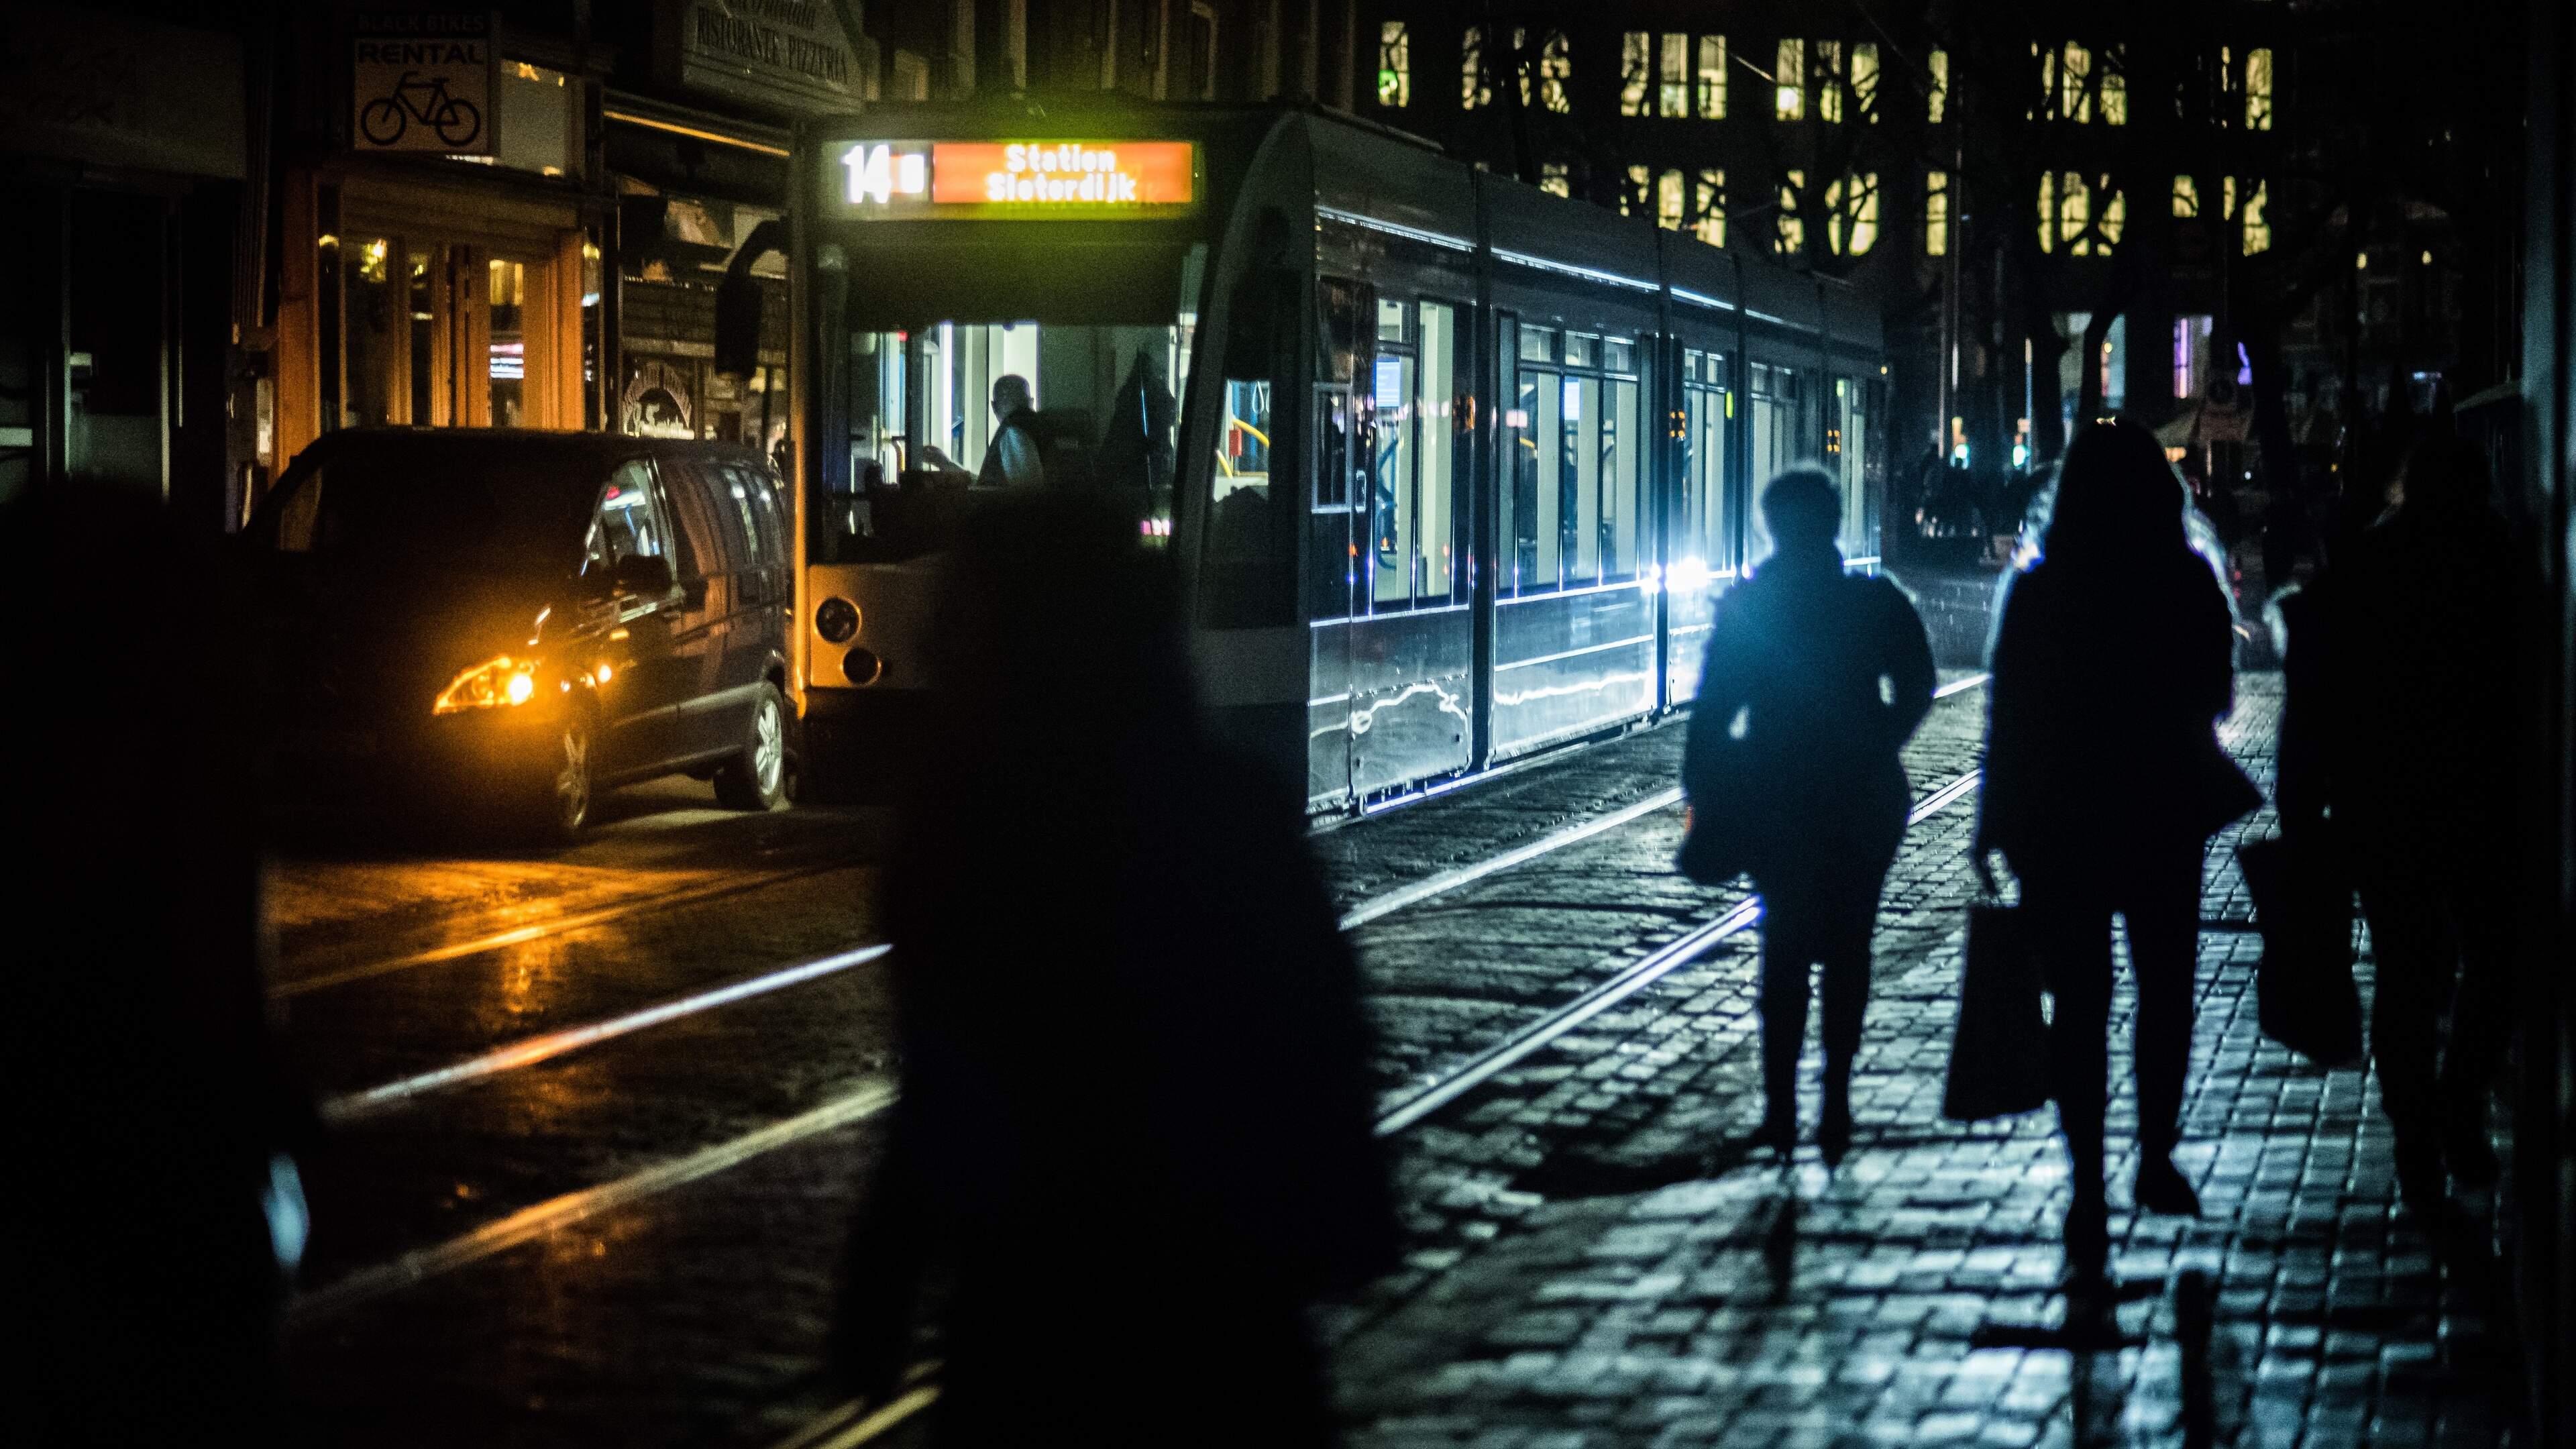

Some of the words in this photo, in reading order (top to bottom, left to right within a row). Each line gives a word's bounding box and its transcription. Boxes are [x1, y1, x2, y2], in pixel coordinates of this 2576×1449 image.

[358, 14, 419, 32] BLACK
[426, 14, 484, 32] BIKES
[358, 43, 484, 64] RENTAL
[697, 7, 780, 66] RISTORANTE
[788, 34, 849, 85] PIZZERIA
[1006, 144, 1115, 172] Station
[841, 144, 891, 203] 14
[987, 172, 1136, 203] Sloterdijk
